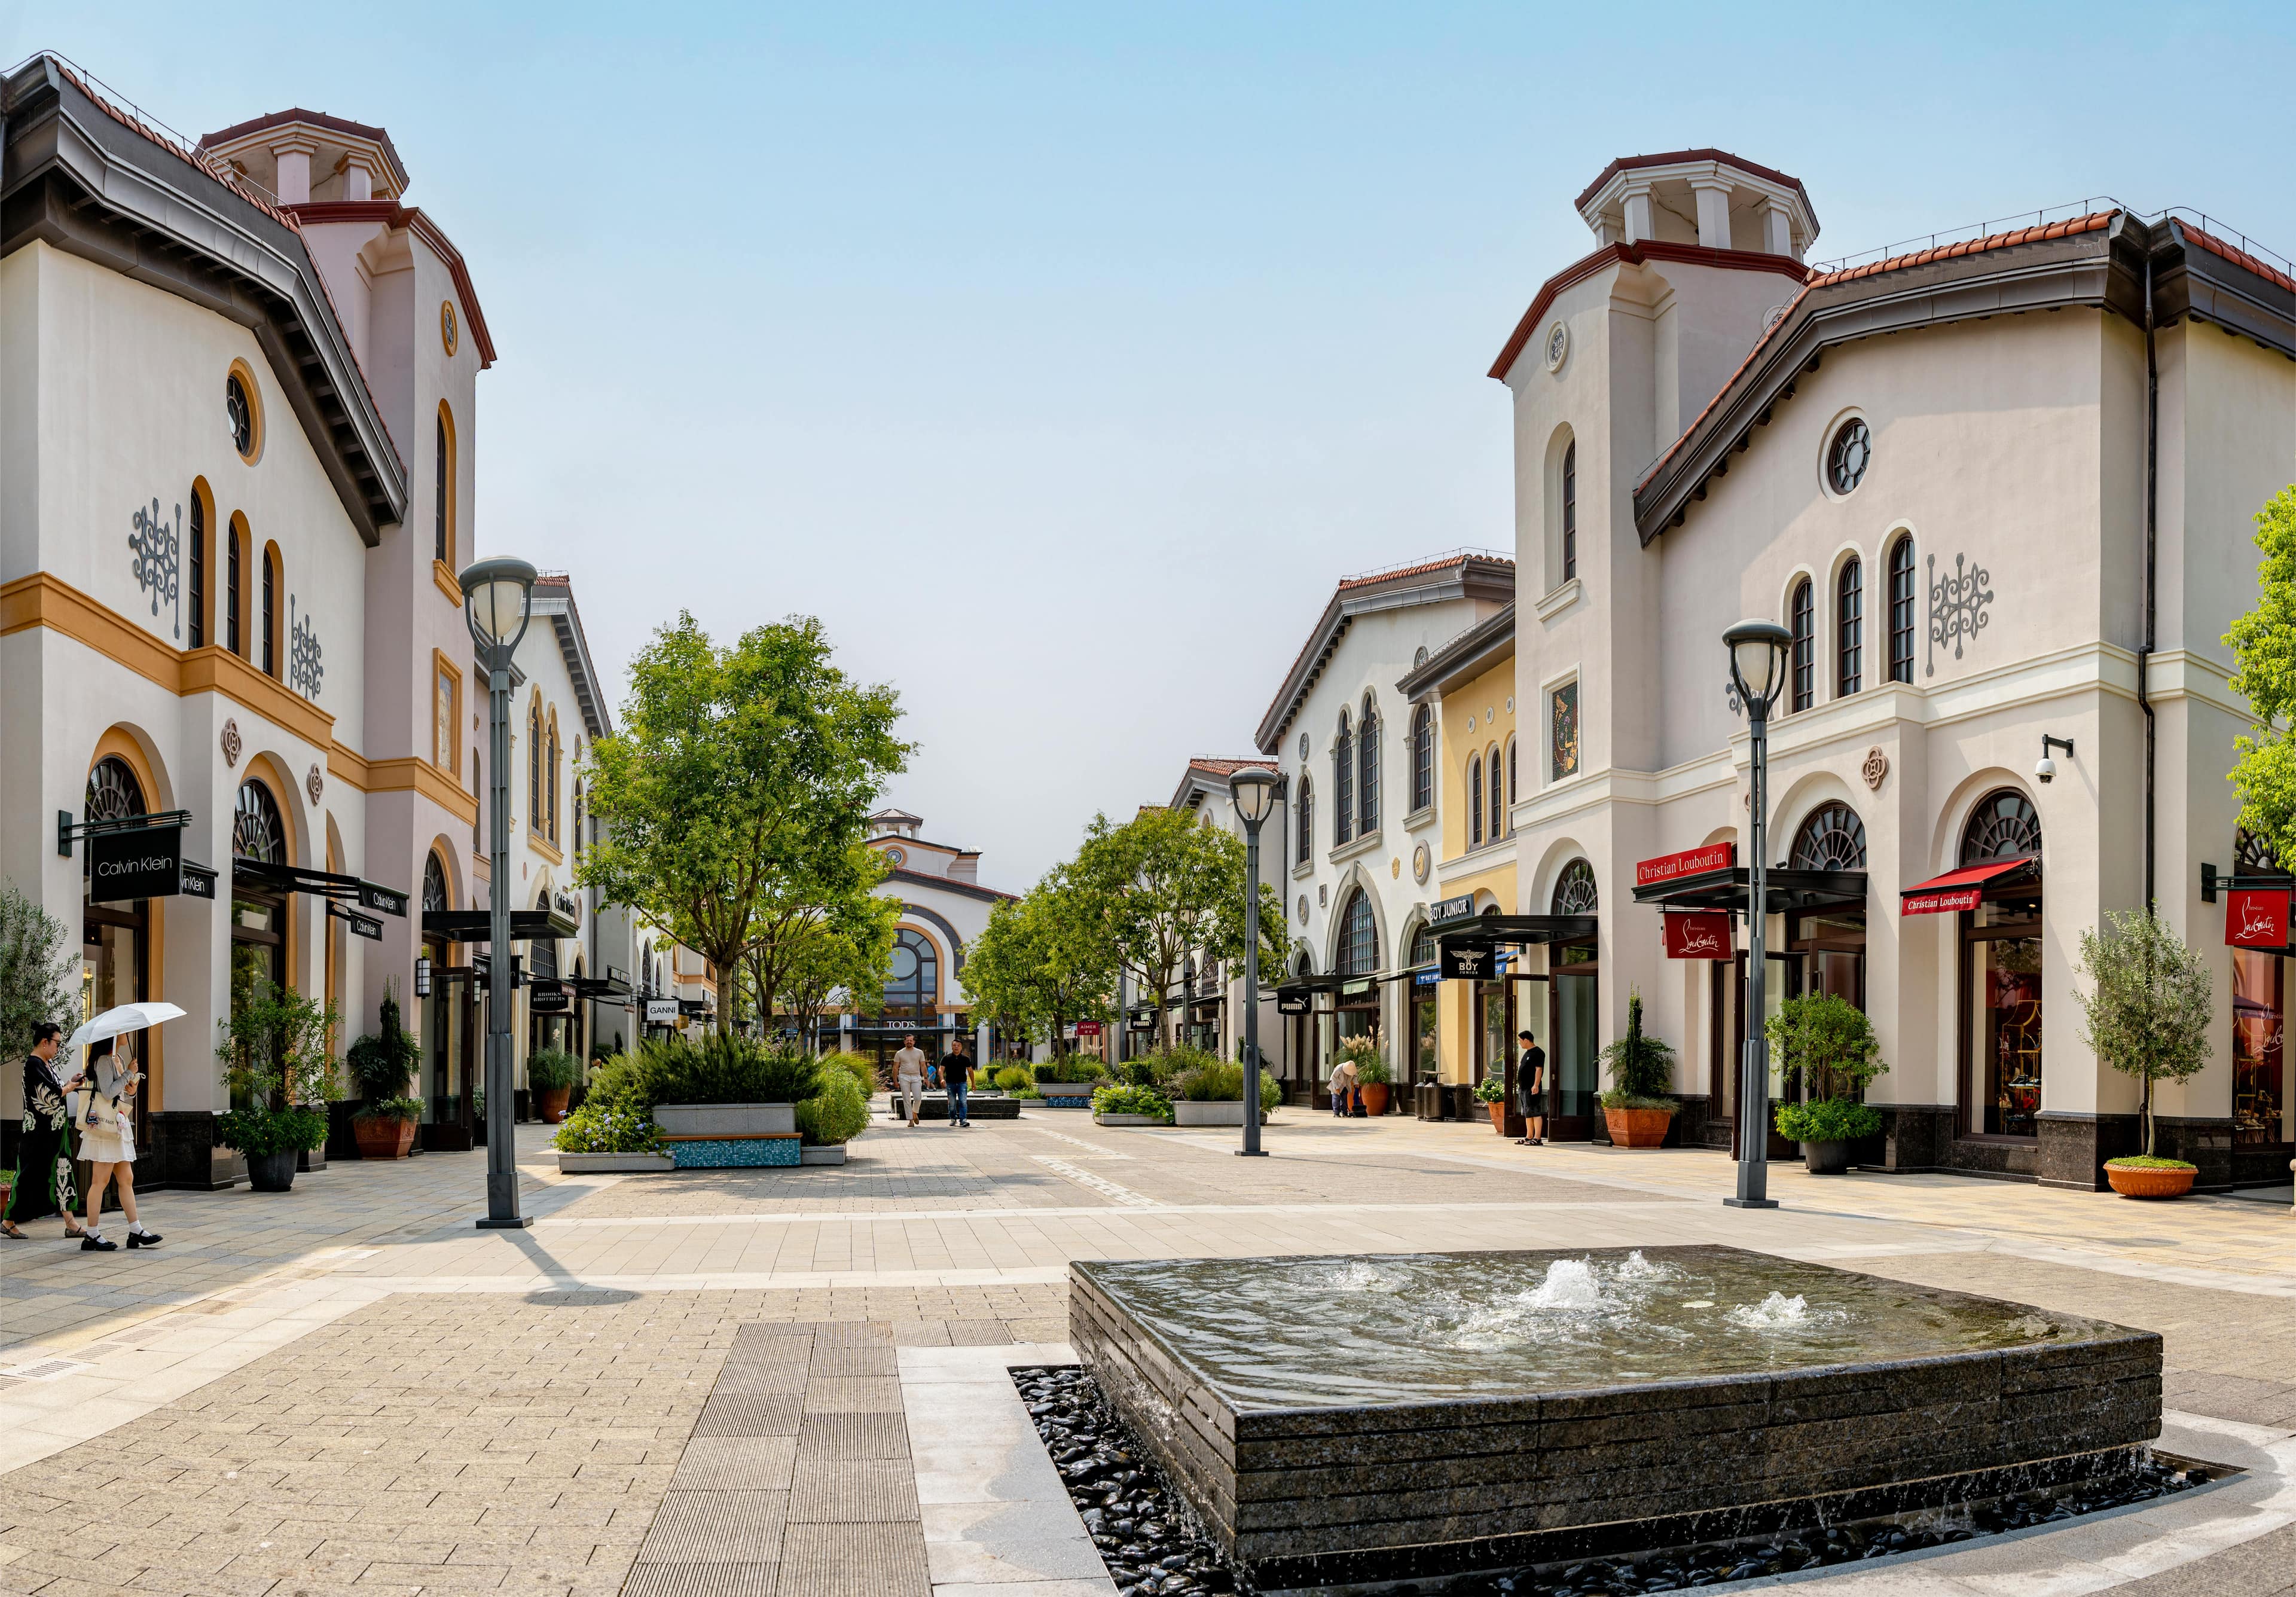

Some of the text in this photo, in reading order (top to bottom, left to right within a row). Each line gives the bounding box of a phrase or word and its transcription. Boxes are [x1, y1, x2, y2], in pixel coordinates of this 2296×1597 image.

[99, 856, 172, 876] Calvin Klein
[1639, 851, 1723, 880] Christian Louboutin
[1430, 899, 1467, 921] BOY JUNIOR
[1908, 895, 1973, 909] Christian Louboutin
[2235, 896, 2274, 939] Louboutin
[1678, 919, 1720, 953] Louboutin
[887, 1021, 915, 1029] TOD'S
